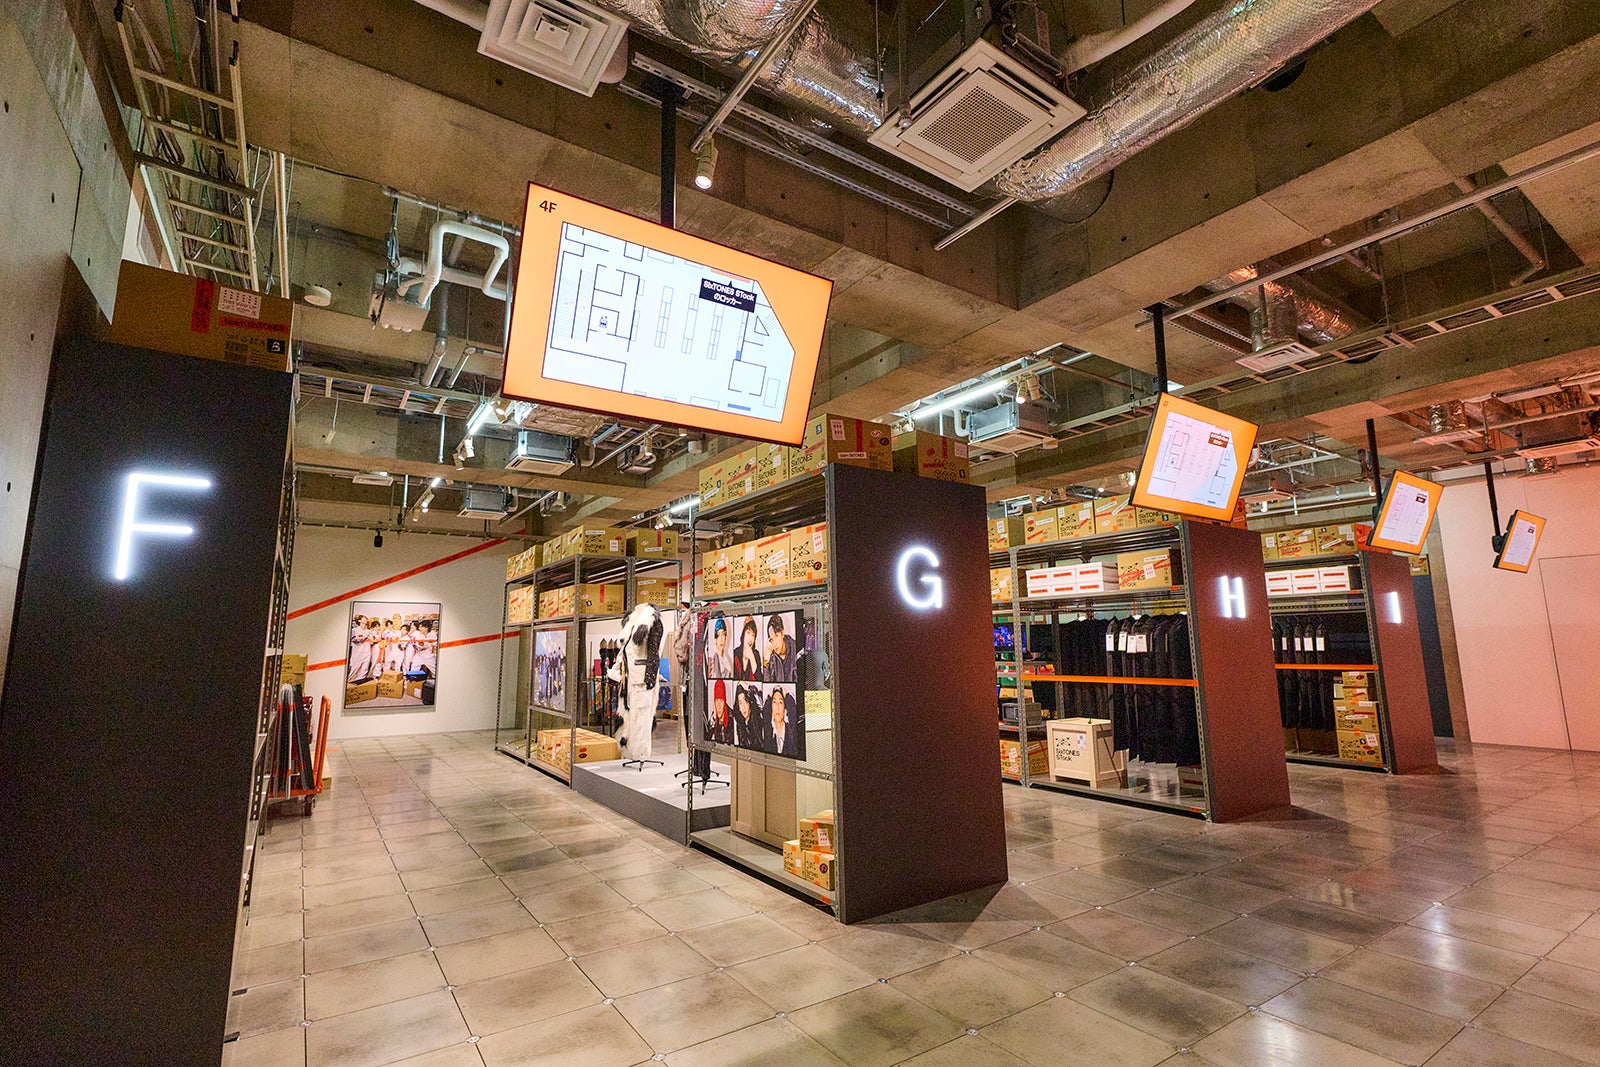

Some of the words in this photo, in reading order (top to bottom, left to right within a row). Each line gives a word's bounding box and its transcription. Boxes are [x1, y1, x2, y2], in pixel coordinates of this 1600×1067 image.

[539, 200, 557, 213] 4F
[703, 280, 735, 296] SixTONES
[713, 292, 742, 305] のロッカー
[115, 472, 212, 581] F
[897, 546, 943, 609] G
[1219, 575, 1246, 618] H
